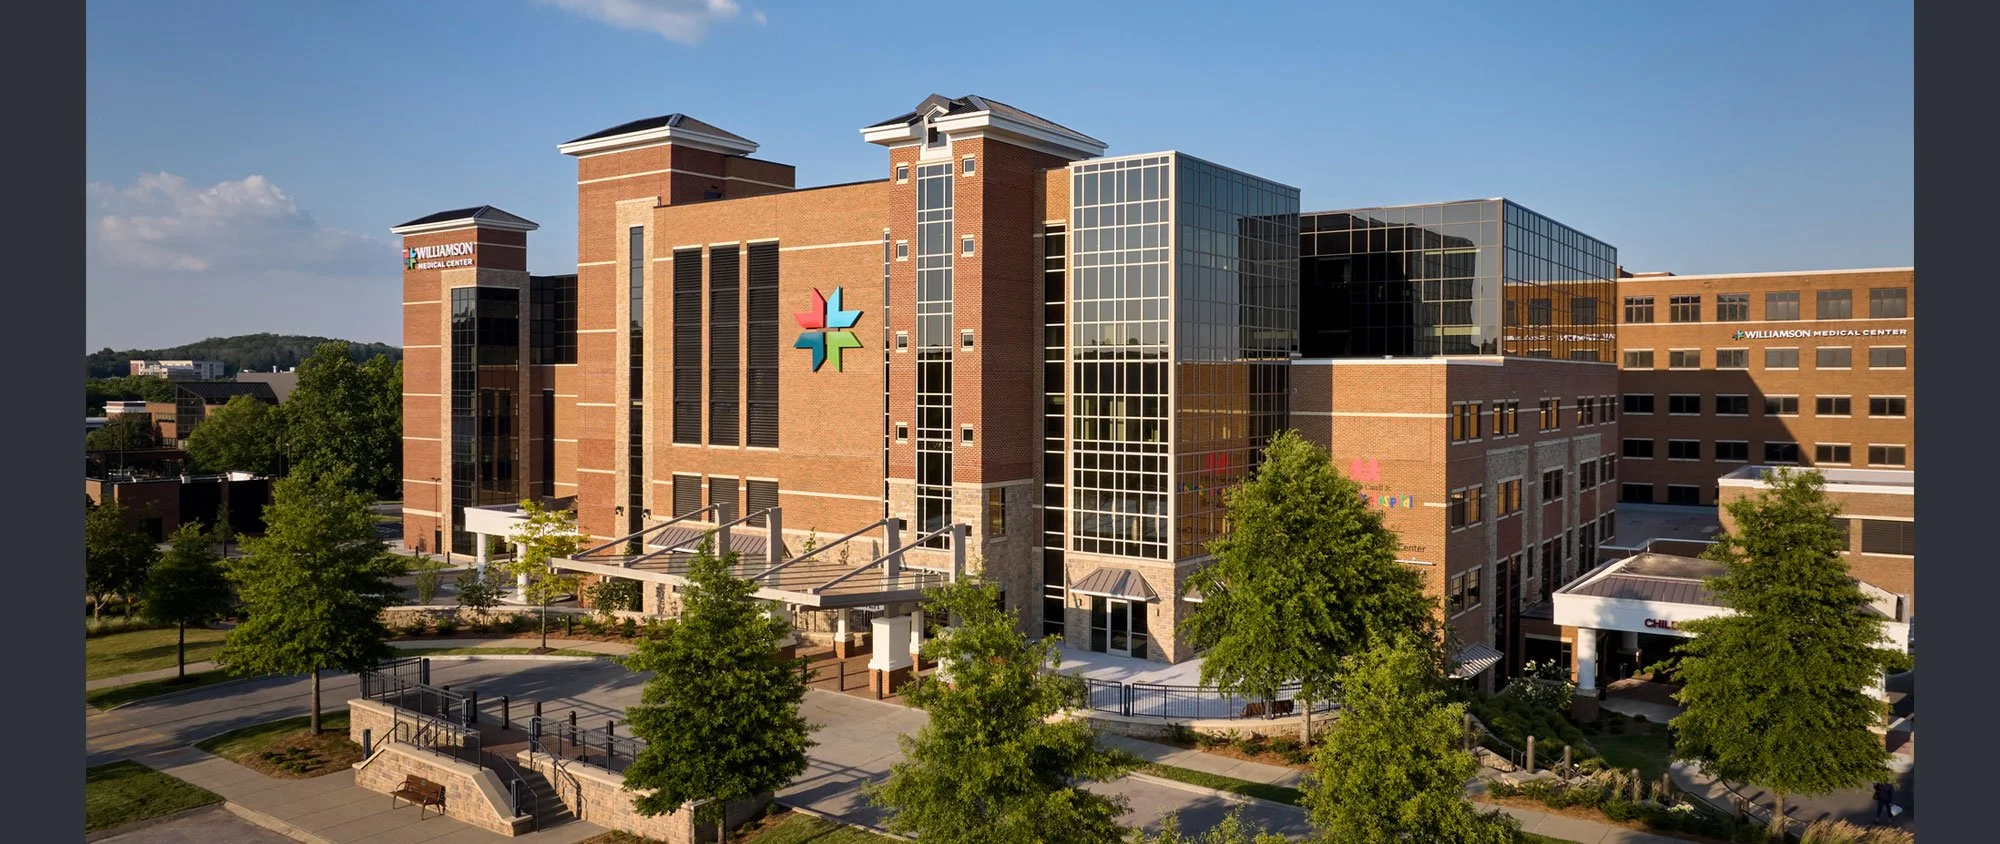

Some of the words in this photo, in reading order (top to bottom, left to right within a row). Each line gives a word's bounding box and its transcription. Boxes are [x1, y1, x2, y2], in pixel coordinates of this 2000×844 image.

[415, 242, 473, 259] WILLIAMSON
[417, 260, 445, 270] MEDICAL
[446, 258, 473, 268] CENTER
[1745, 329, 1811, 340] WILLIAMSON
[1644, 618, 1679, 630] CHILD
